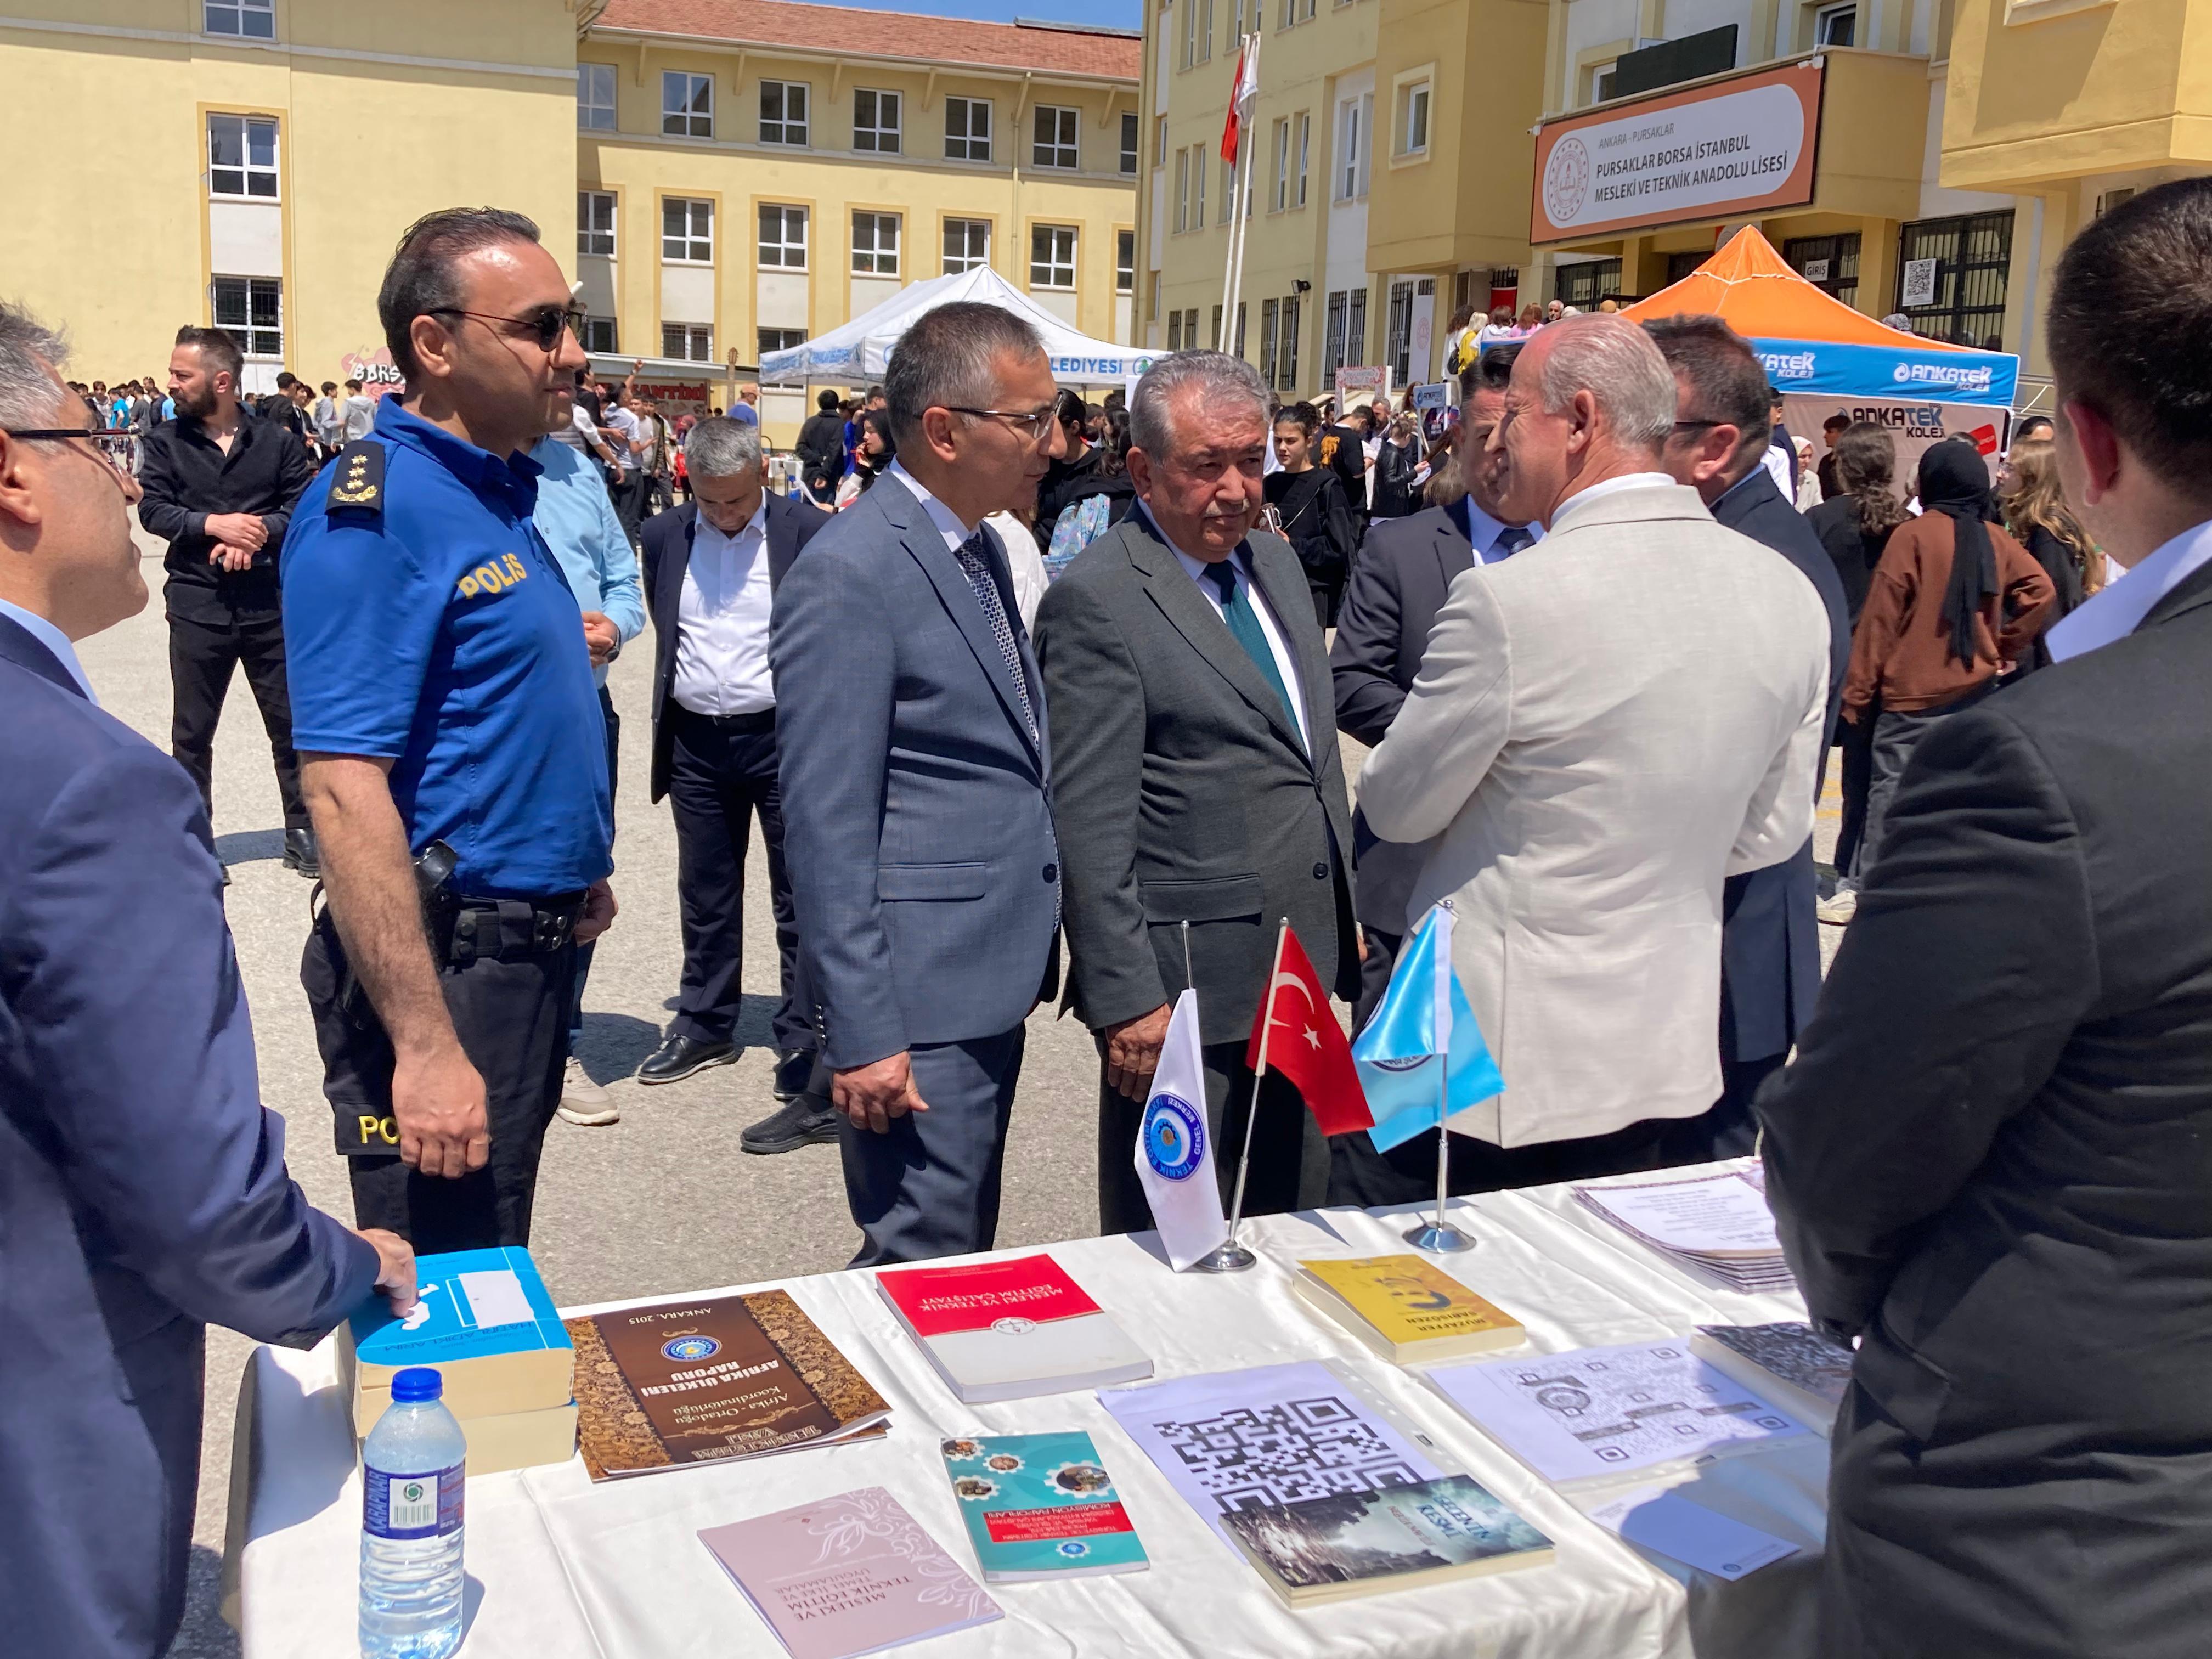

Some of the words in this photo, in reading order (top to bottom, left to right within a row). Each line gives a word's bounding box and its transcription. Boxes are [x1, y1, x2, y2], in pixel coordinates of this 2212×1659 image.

[1599, 132, 1627, 150] ANKARA
[1632, 123, 1675, 143] PURSAKLAR
[1596, 153, 1655, 179] PURSAKLAR
[1657, 145, 1692, 167] BORSA
[1696, 134, 1750, 159] İSTANBUL
[1594, 178, 1637, 203] MESLEKİ
[1638, 179, 1650, 195] VE
[1653, 169, 1690, 193] TEKNİK
[1692, 161, 1748, 187] ANADOLU
[1751, 150, 1788, 176] LİSESİ
[1807, 263, 1826, 277] GİRİŞ
[1911, 364, 1993, 384] ANKATEK
[1853, 407, 1943, 427] ANKATEK
[456, 553, 527, 599] POLİS
[1194, 1125, 1202, 1155] GENEL
[1159, 1160, 1194, 1177] TEKNİK
[979, 1299, 1001, 1307] VE
[628, 1316, 653, 1325] 2015
[1416, 1318, 1486, 1331] MUZAFFER
[670, 1361, 740, 1382] RAPORU
[719, 1359, 780, 1385] AFRİKA
[640, 1375, 718, 1397] ÜLKELERİ
[672, 1385, 781, 1414] Koordinatörlüğü
[748, 1392, 788, 1409] Afrika
[674, 1407, 738, 1425] Ortadoğu
[367, 1470, 387, 1533] KARAPINAR
[794, 1611, 816, 1622] VE
